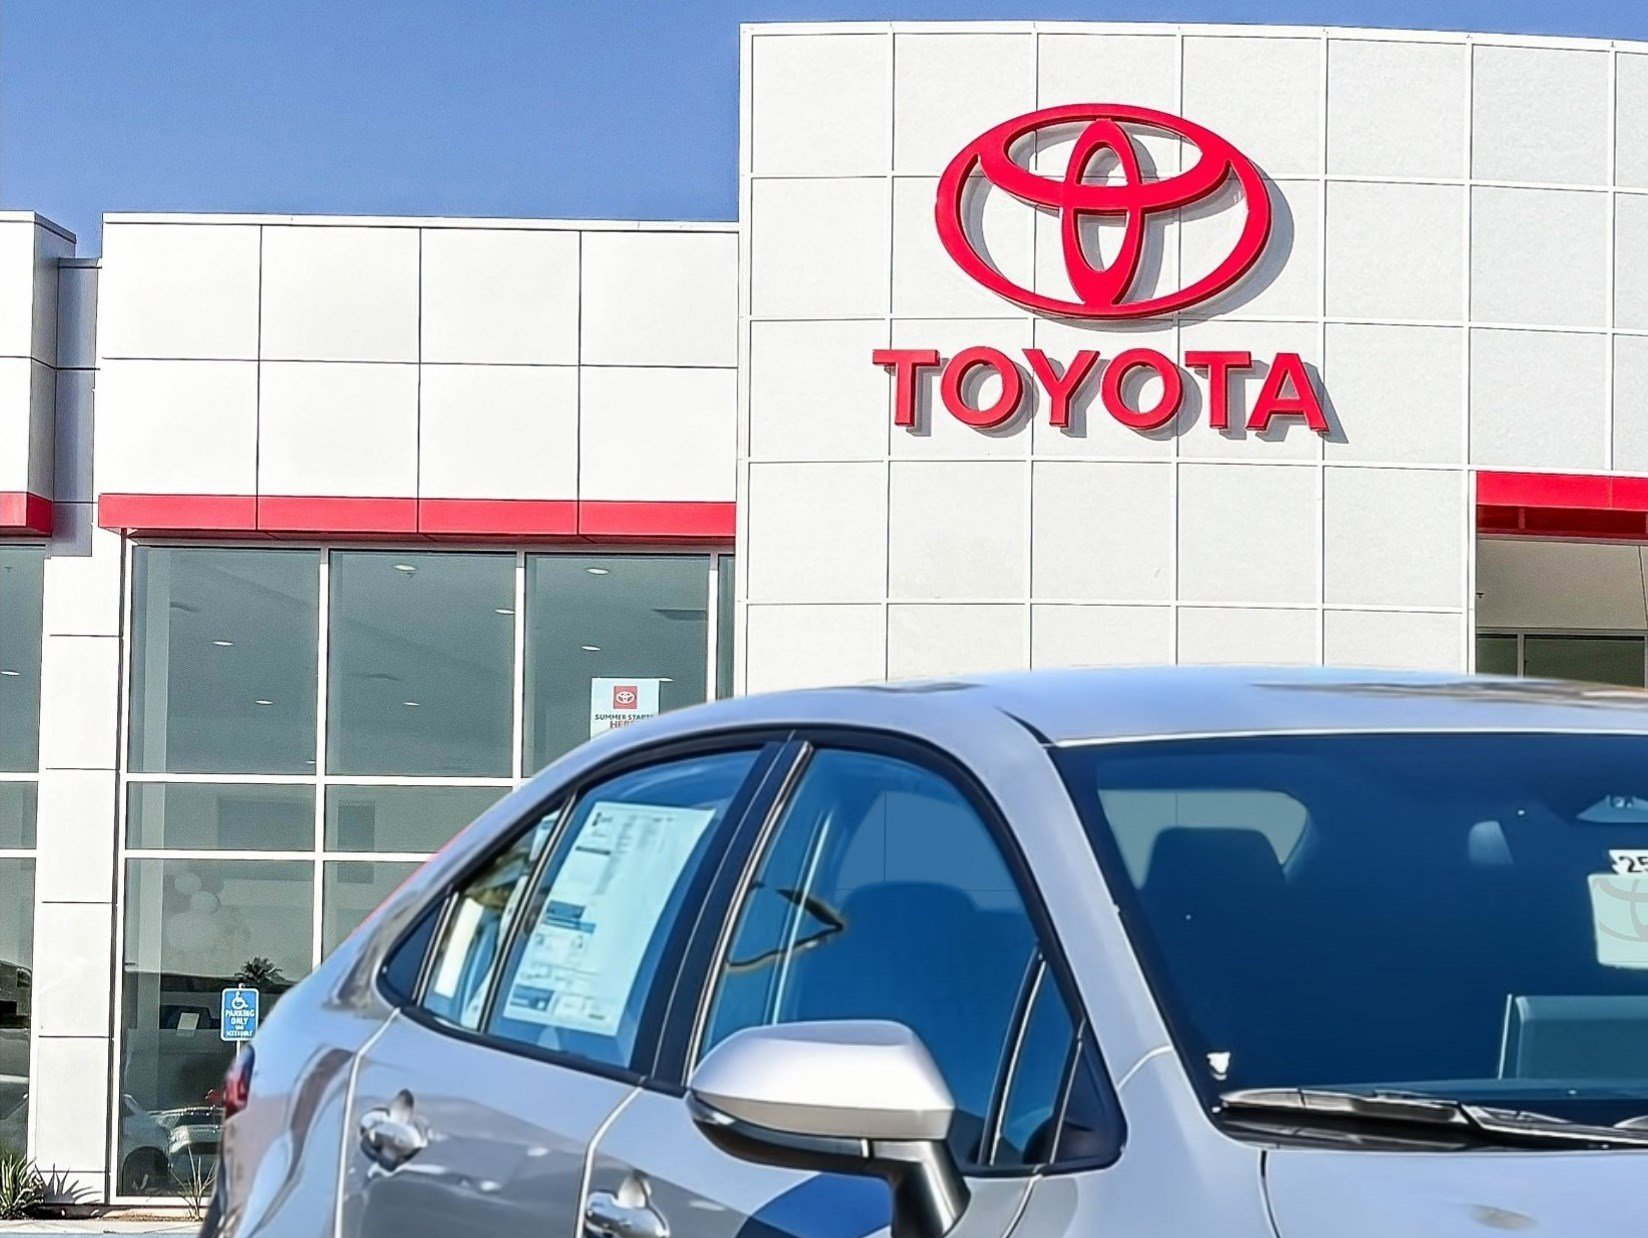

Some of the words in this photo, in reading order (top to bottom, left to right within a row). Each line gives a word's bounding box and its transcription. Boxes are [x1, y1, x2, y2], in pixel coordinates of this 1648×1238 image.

[872, 346, 1330, 434] TOYOTA
[225, 1009, 255, 1017] PARKING
[231, 1017, 249, 1025] ONLY
